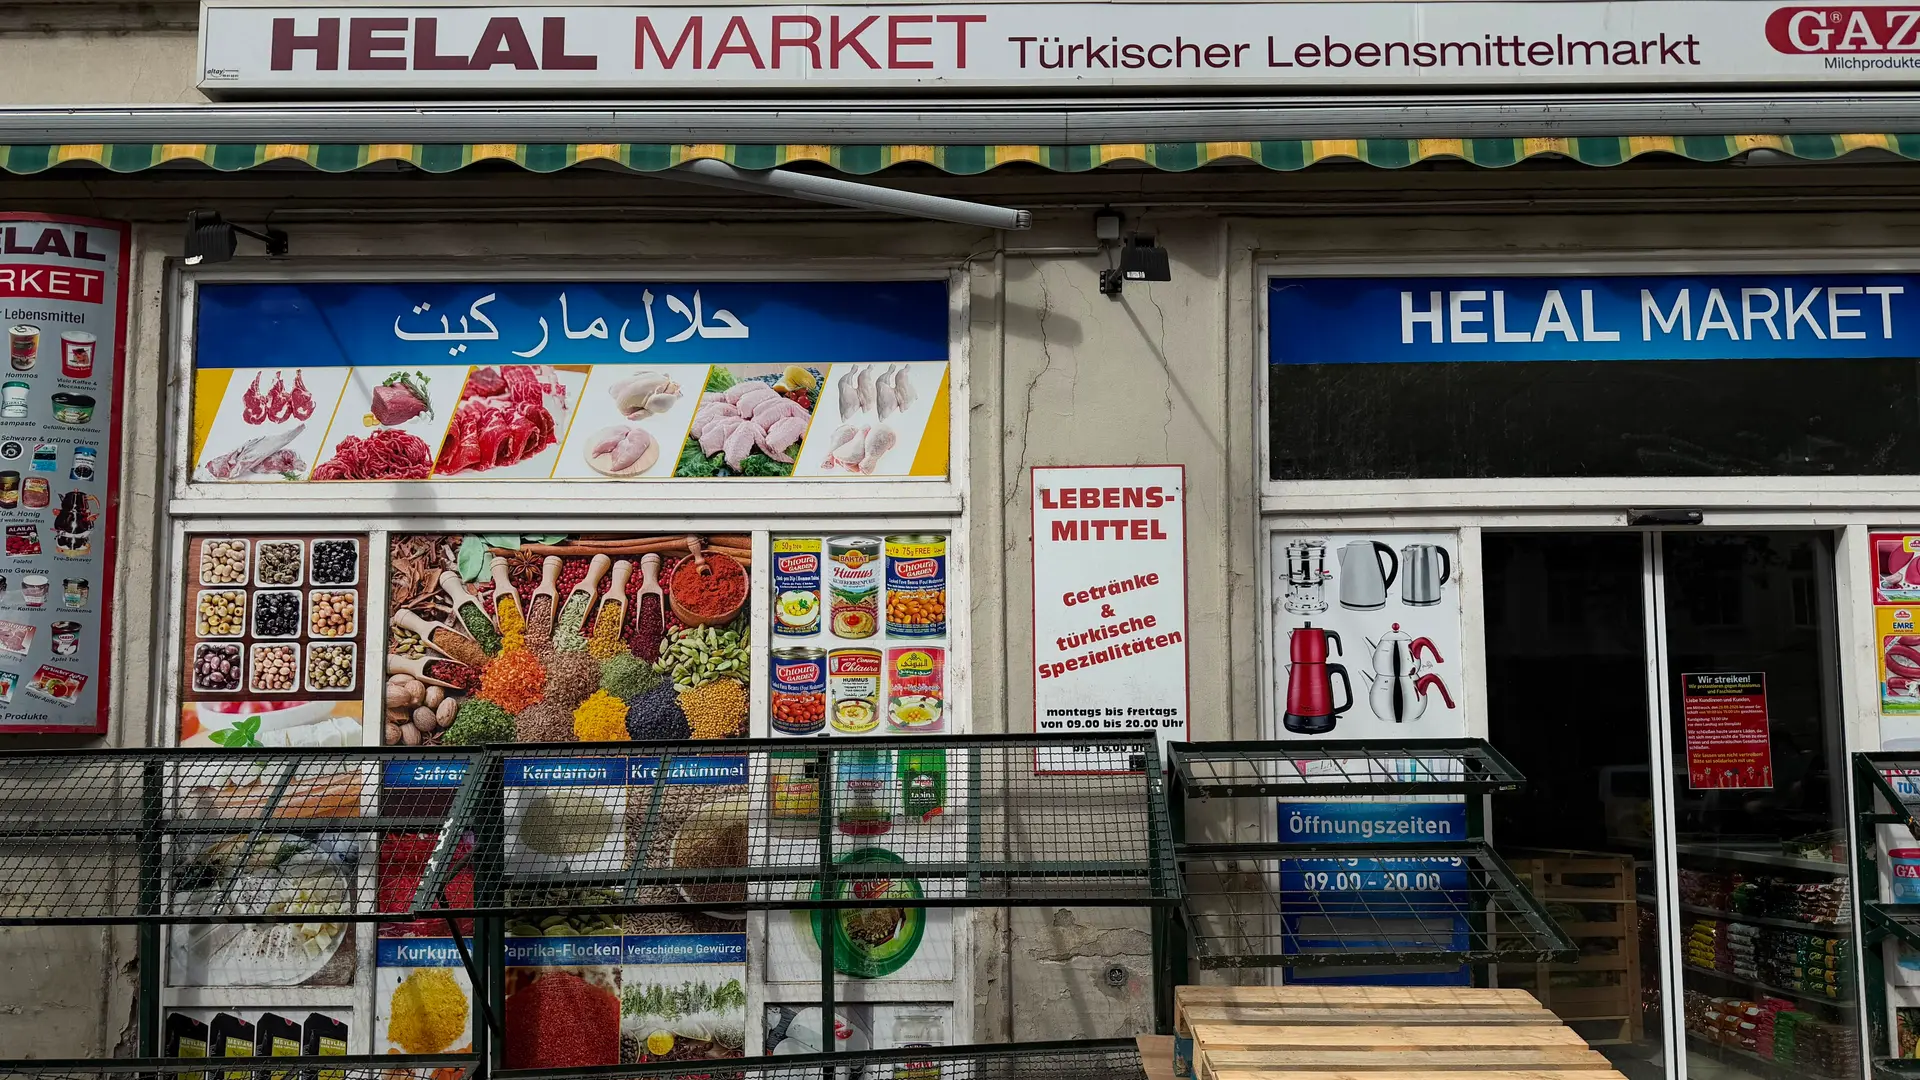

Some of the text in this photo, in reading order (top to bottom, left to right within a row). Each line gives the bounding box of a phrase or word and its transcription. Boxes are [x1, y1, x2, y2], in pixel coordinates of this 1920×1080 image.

[271, 16, 987, 70] HELAL MARKET
[1008, 33, 1700, 70] Türkischer Lebensmittelmarkt
[1824, 57, 1920, 71] Milchprodukte
[0, 226, 106, 262] LAL
[5, 308, 84, 324] Lebensmittel
[620, 289, 749, 353] حلال
[1401, 286, 1904, 344] HELAL MARKET
[394, 292, 499, 357] كيت
[1, 434, 37, 442] Schwarze
[47, 436, 71, 444] grüne
[74, 437, 99, 446] Oliven
[1042, 486, 1175, 510] LEBENS-
[1051, 519, 1167, 541] MITTEL
[833, 567, 873, 579] Humus
[898, 561, 934, 573] Chtoura
[907, 568, 933, 577] GARDEN
[1062, 572, 1160, 607] Getränke
[1100, 604, 1116, 618] &
[1056, 615, 1157, 651] türkische
[1038, 630, 1183, 679] Spezialitäten
[779, 666, 815, 677] Chtoura
[787, 673, 814, 682] GARDEN
[1697, 674, 1751, 684] Wir streiken!
[1046, 707, 1177, 717] montags bis freitags
[1041, 719, 1184, 729] von 09.00 bis 20.00 Uhr
[523, 765, 607, 779] Kardamon
[631, 764, 744, 778] Krezkümmel
[1289, 811, 1451, 838] Öffnungszeiten
[1304, 872, 1361, 891] 09.00
[1383, 872, 1441, 891] 20.00
[397, 945, 474, 960] Kurkum
[627, 944, 742, 956] Verschidene Gewürze
